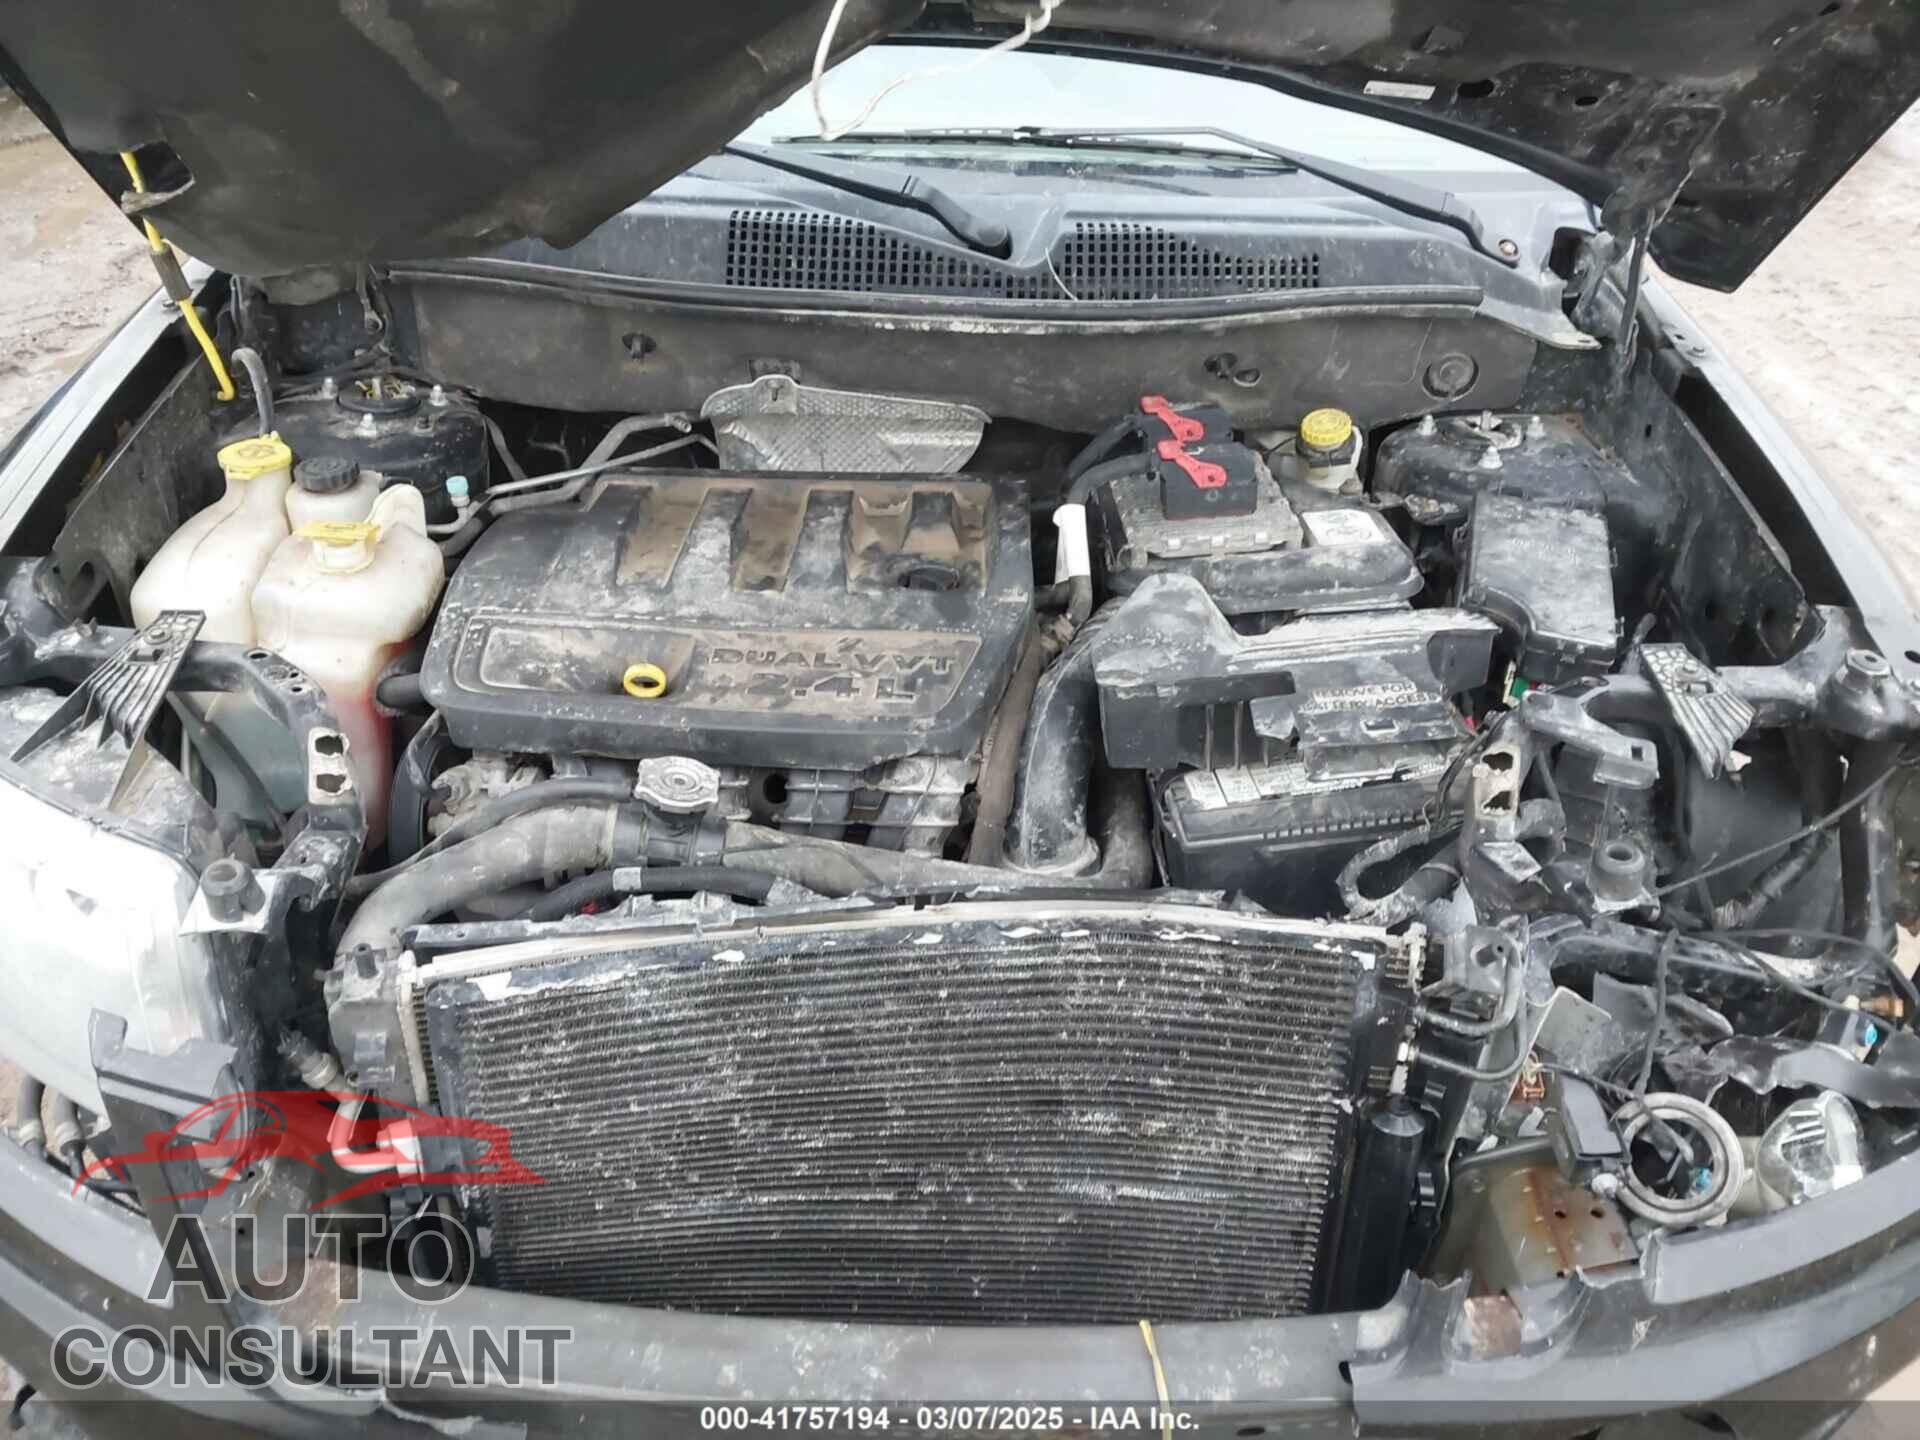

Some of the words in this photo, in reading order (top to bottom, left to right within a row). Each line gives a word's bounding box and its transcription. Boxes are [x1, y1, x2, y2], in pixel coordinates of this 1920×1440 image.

[709, 648, 842, 669] DUAL
[853, 651, 955, 675] VVT
[747, 670, 918, 701] 2.4L
[1381, 680, 1417, 694] FOR
